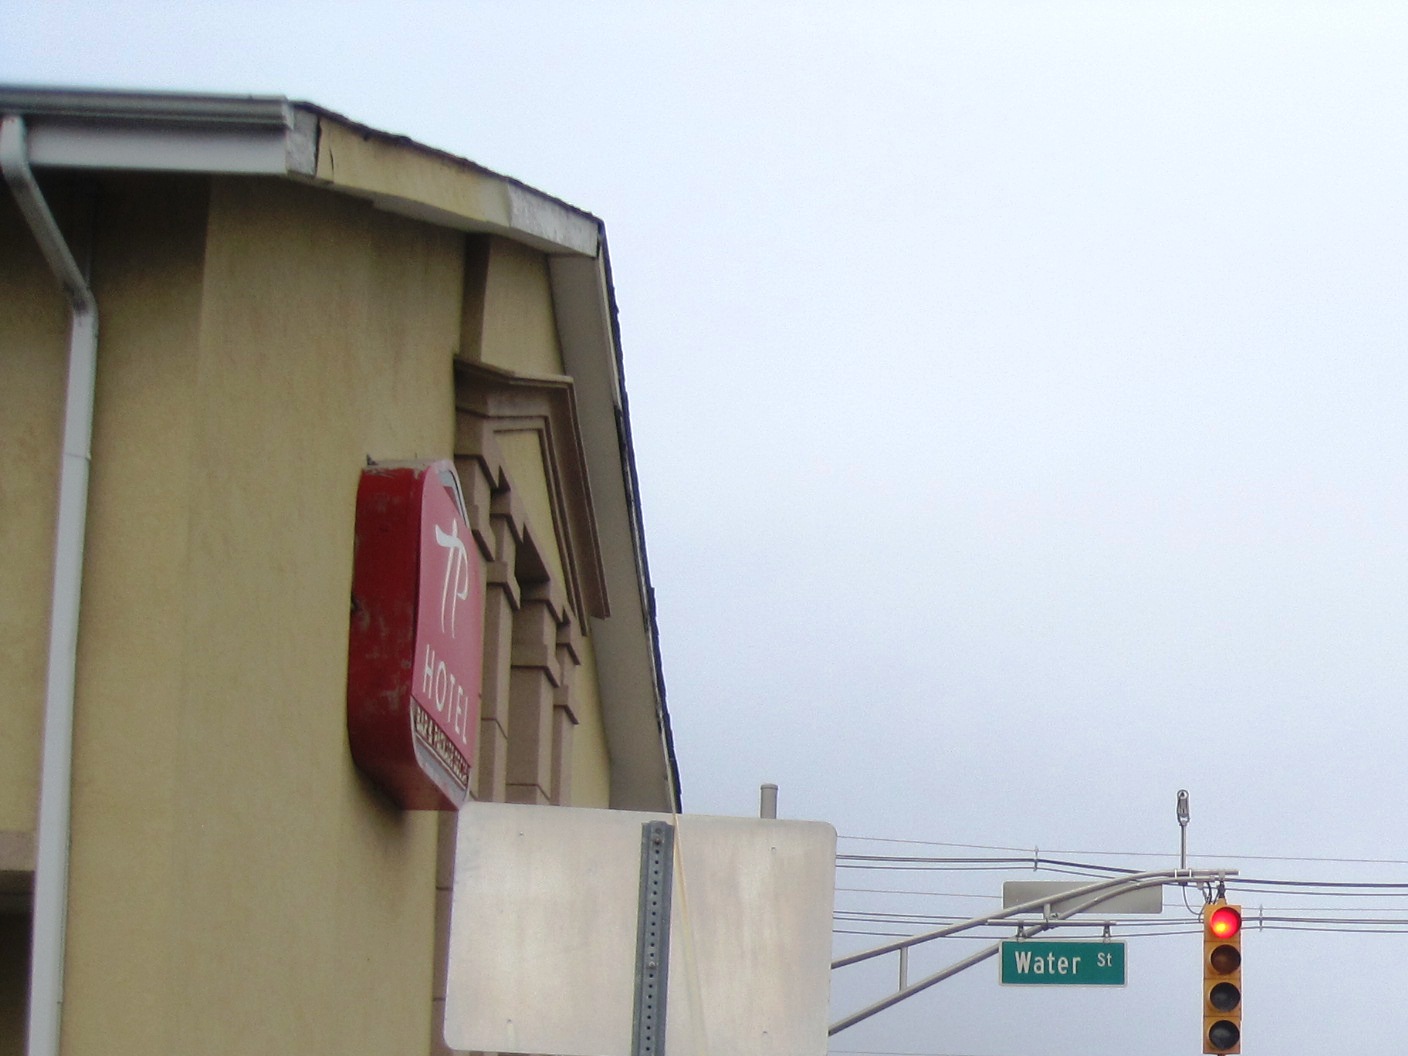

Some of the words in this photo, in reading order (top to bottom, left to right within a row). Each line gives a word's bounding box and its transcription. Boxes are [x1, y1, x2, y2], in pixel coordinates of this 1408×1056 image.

[422, 643, 470, 745] HOTEL
[1014, 951, 1082, 975] Water
[1096, 952, 1113, 968] St
